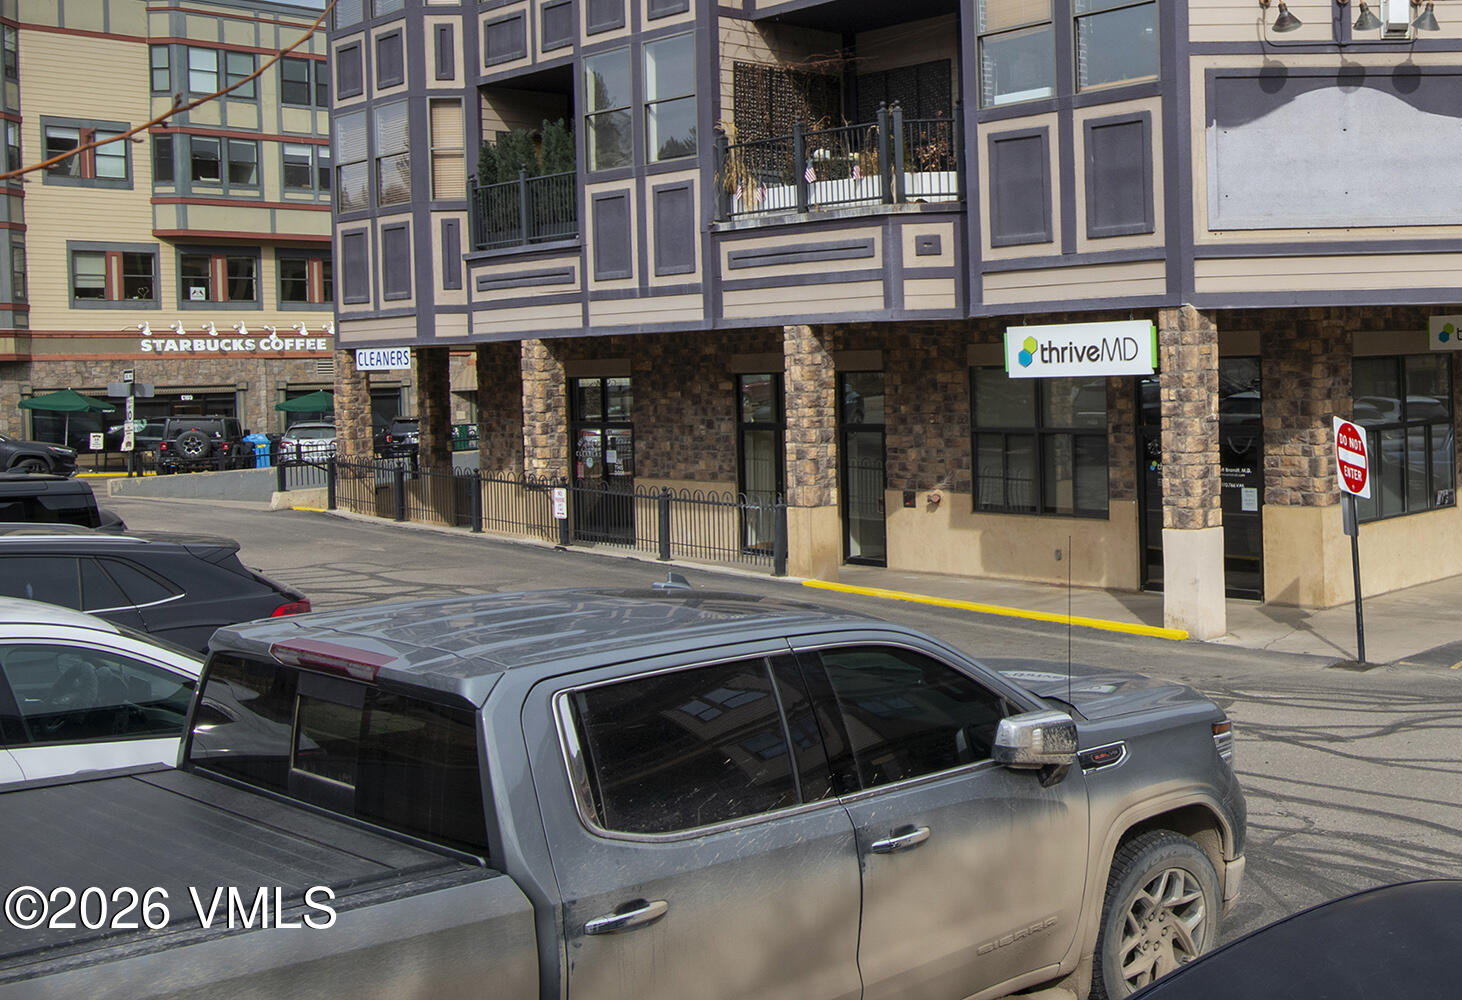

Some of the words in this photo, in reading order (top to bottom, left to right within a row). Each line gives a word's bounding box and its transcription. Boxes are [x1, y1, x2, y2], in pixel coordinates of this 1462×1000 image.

[140, 338, 256, 352] STARBUCKS
[258, 338, 327, 352] COFFEE
[1040, 336, 1139, 364] thriveMD
[357, 350, 410, 367] CLEANERS
[1338, 433, 1348, 446] DO
[1348, 437, 1362, 452] NOT
[1343, 466, 1363, 481] ENTER
